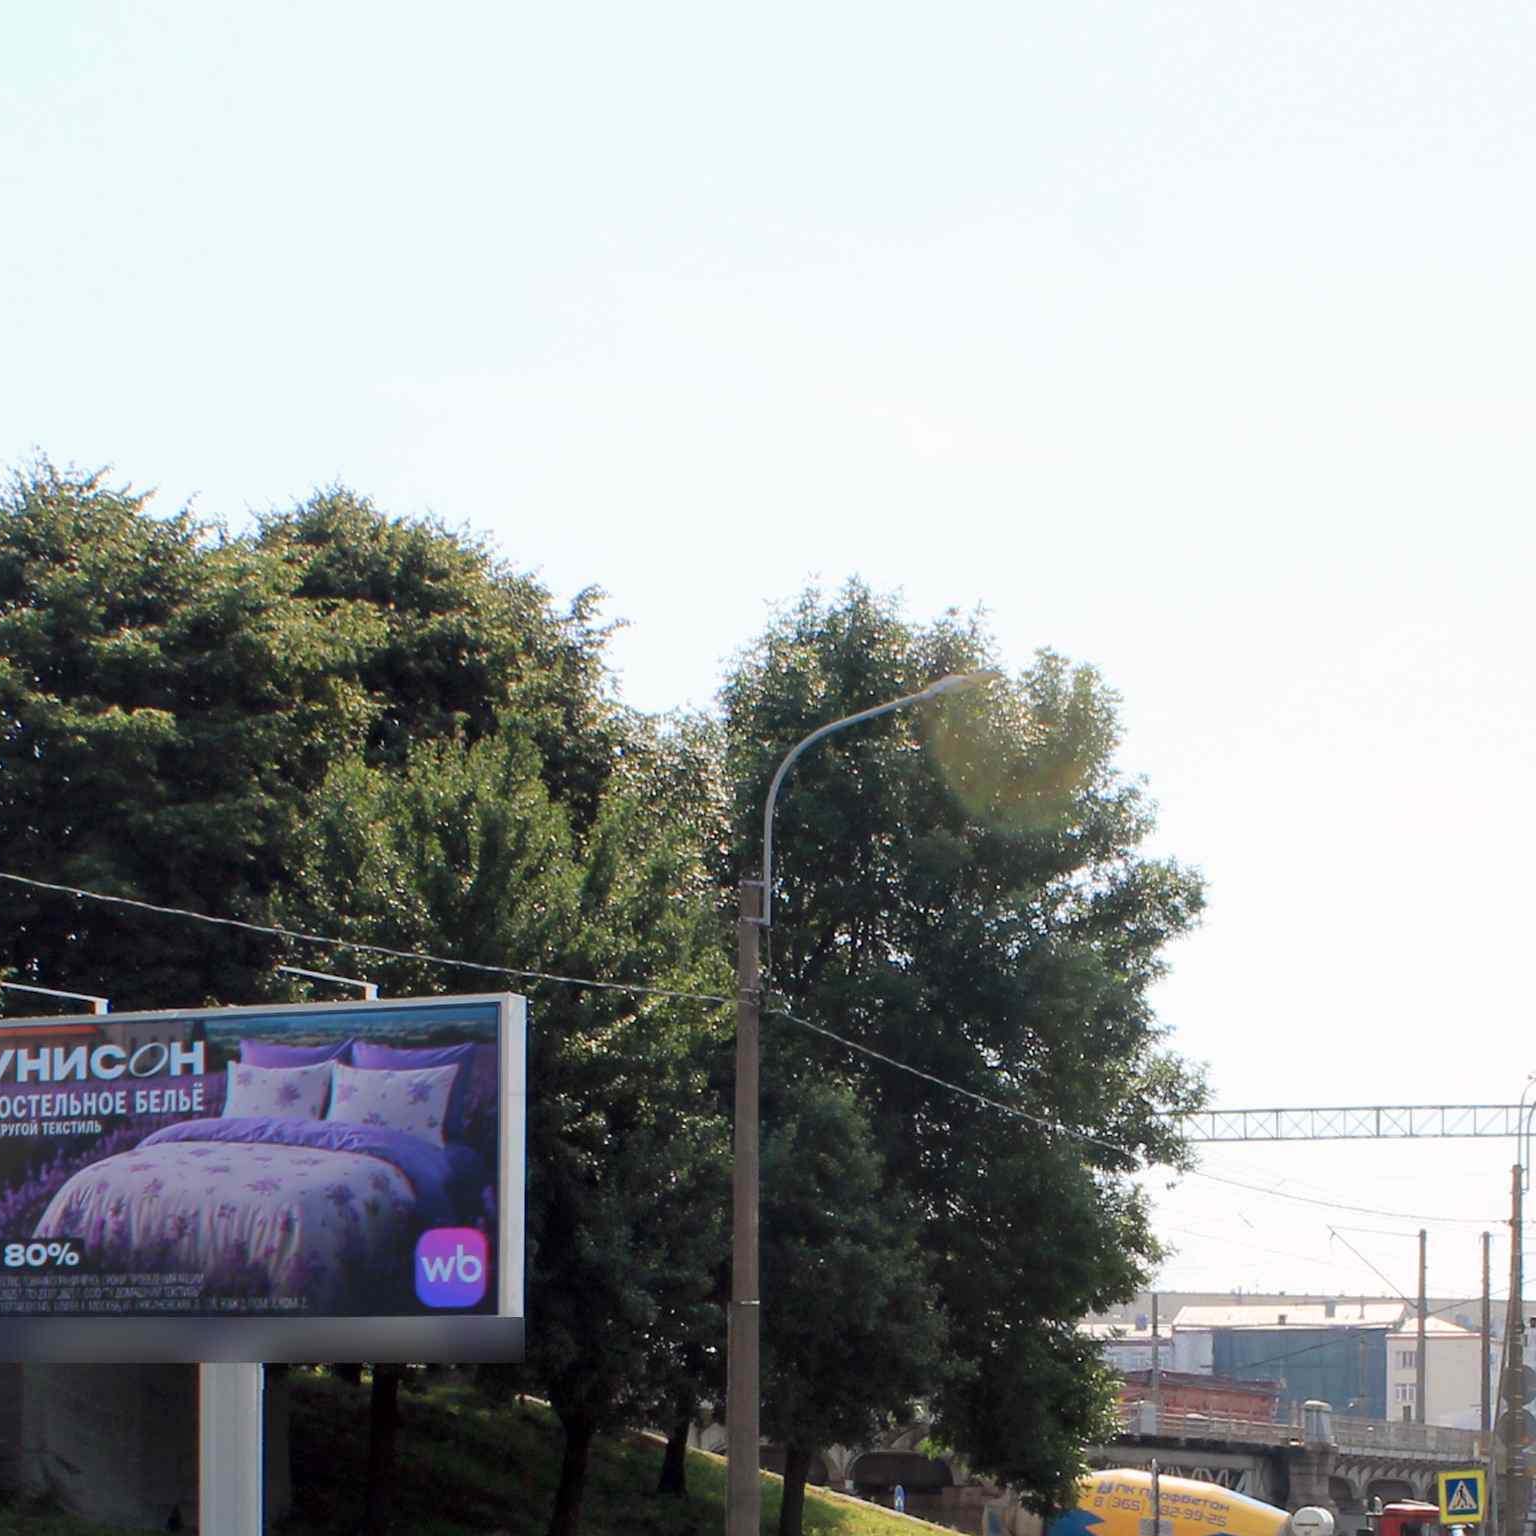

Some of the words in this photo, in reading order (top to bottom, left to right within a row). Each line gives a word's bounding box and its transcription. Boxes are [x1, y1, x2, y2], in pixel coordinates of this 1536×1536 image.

[134, 1082, 205, 1114] БЕЛЬЁ
[42, 1118, 102, 1137] ТЕКСТИЛЬ
[420, 1243, 482, 1284] wb
